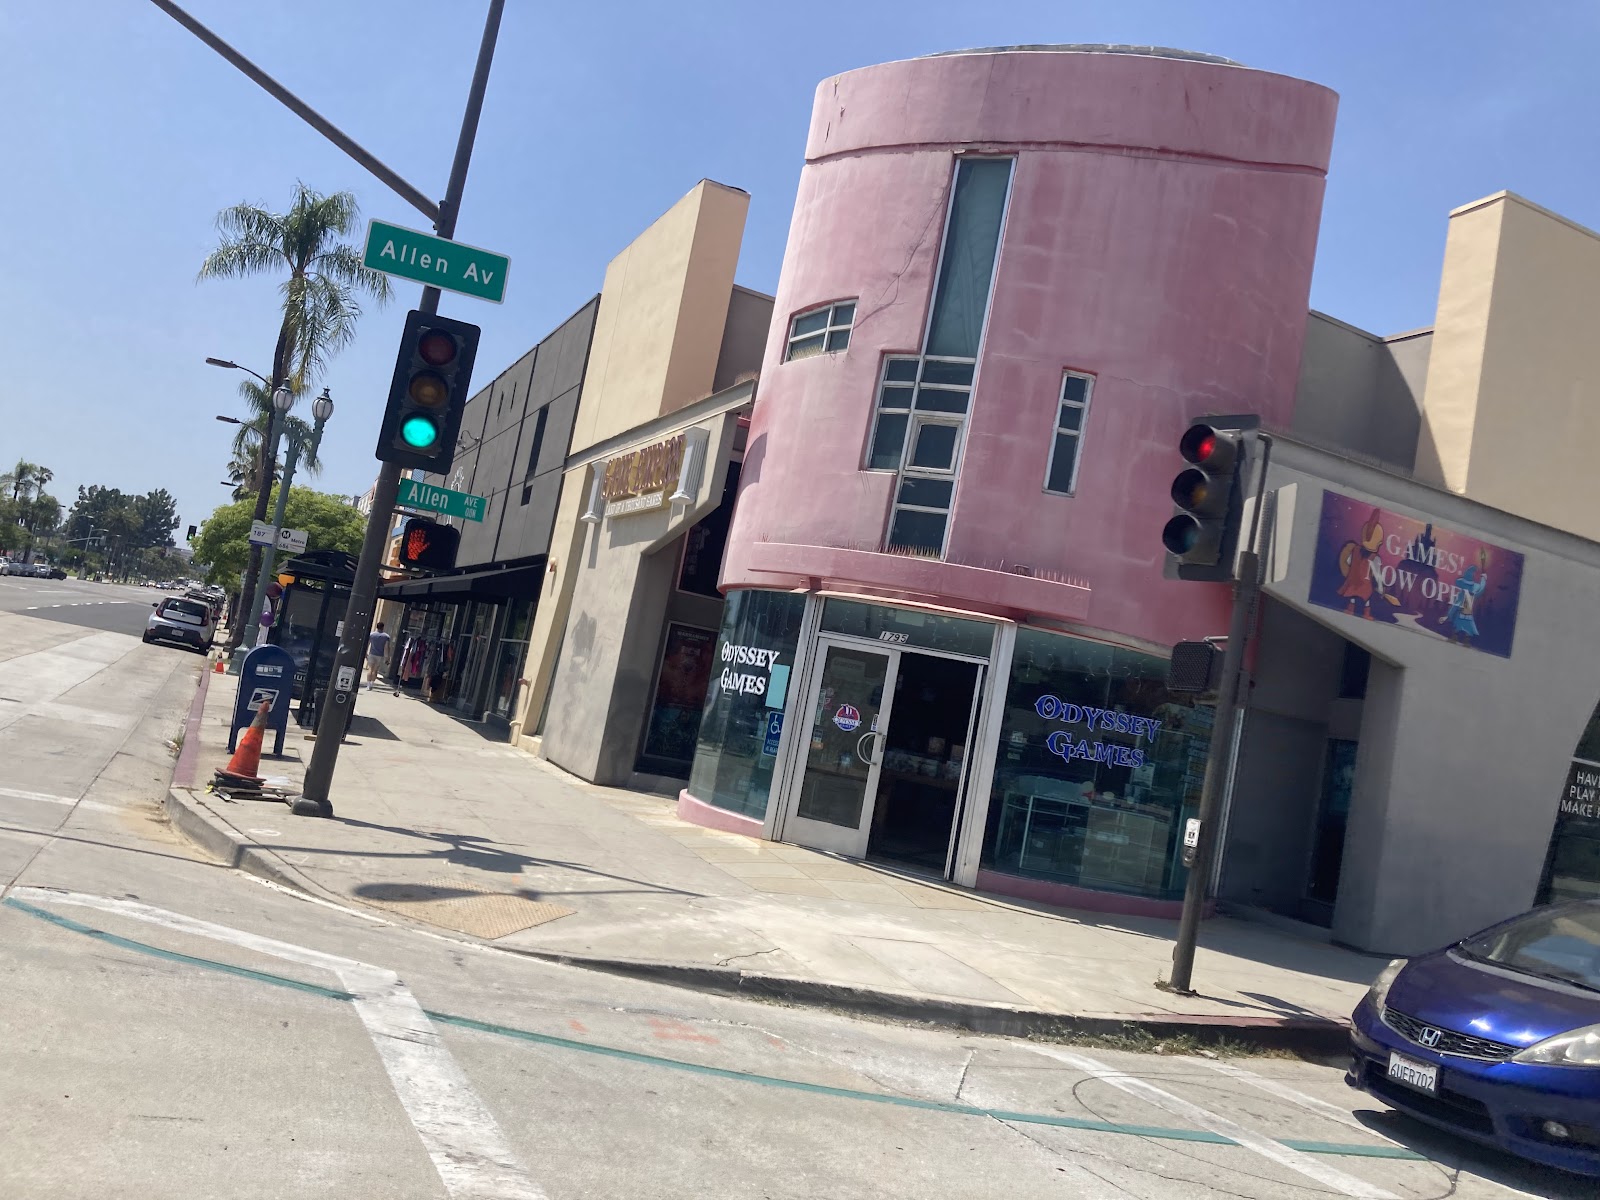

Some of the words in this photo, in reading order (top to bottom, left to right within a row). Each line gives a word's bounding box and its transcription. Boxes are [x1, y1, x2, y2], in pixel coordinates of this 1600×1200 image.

[380, 240, 448, 274] Allen
[463, 263, 494, 285] Av
[407, 483, 449, 510] Allen
[464, 496, 480, 509] AVE
[1386, 534, 1465, 576] GAMES!
[1364, 559, 1418, 596] NOW
[1421, 577, 1475, 610] OPEN
[881, 632, 907, 643] 1795
[721, 641, 780, 673] ODYSSEY
[720, 667, 766, 696] GAMES
[1034, 694, 1162, 743] ODYSSEY
[1046, 730, 1145, 769] GAMES
[1570, 785, 1595, 801] PLAY
[1561, 800, 1593, 817] MAKE
[1390, 1063, 1434, 1090] 6UER702
